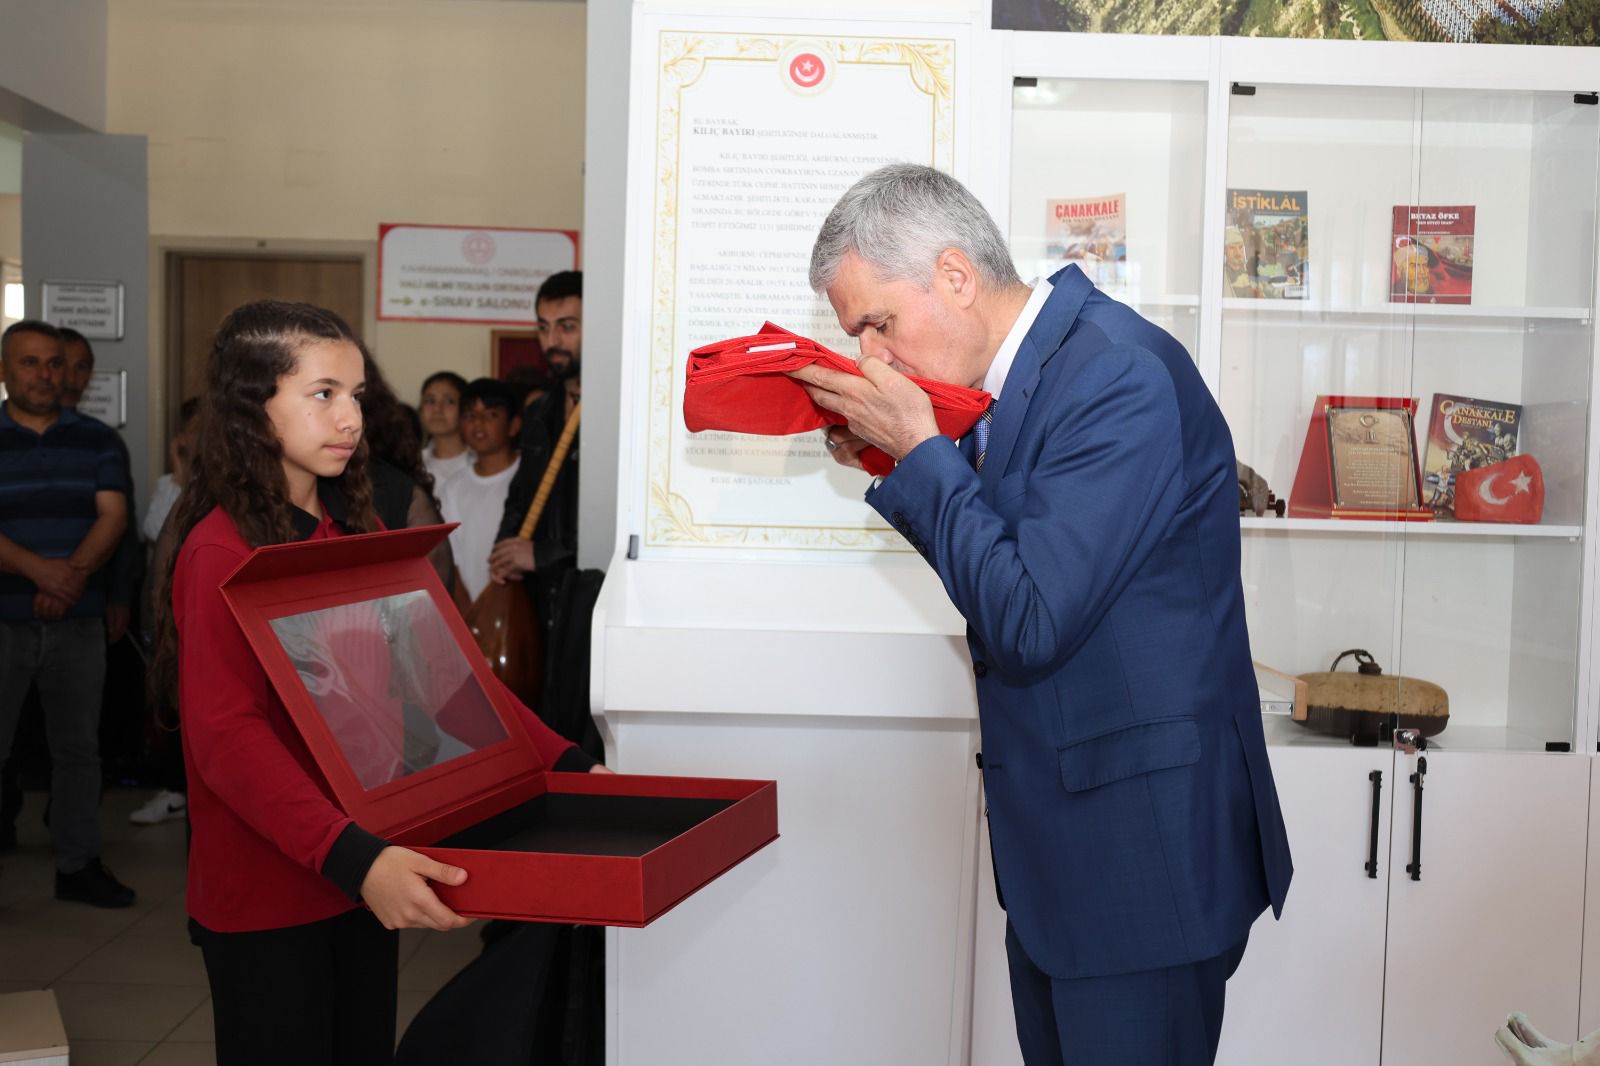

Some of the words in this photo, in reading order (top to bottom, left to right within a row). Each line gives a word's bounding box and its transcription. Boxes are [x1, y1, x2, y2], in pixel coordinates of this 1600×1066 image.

[692, 127, 720, 137] KILIÇ
[722, 128, 755, 137] BAYIRI
[1055, 199, 1120, 220] ÇANAKKALE
[1438, 211, 1460, 220] ÖFKE
